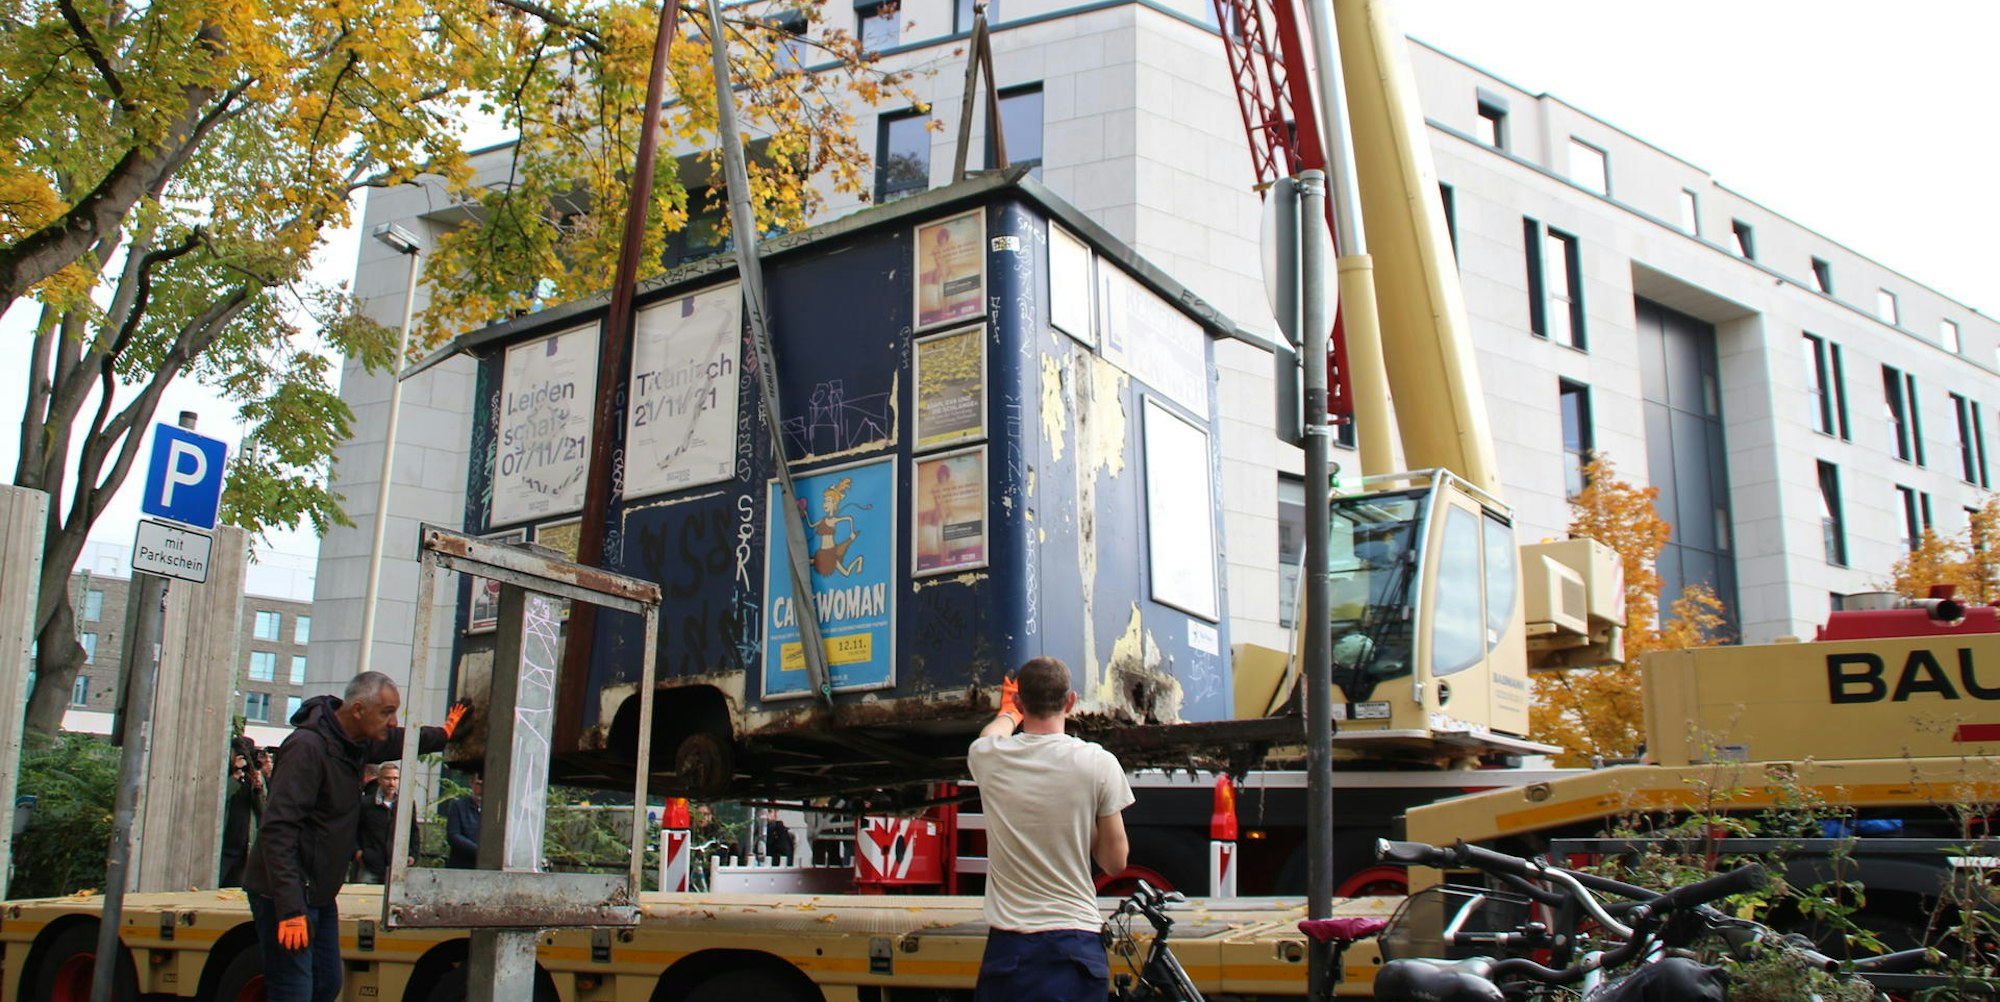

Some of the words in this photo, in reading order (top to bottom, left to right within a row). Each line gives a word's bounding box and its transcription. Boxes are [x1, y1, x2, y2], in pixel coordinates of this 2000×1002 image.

[636, 352, 733, 398] Titanisch
[508, 380, 575, 416] Leiden
[634, 387, 717, 428] 21/11/21
[160, 438, 208, 508] P
[501, 435, 586, 477] 07/11/21
[139, 546, 204, 571] Parkschein
[165, 536, 184, 551] mit
[773, 582, 887, 629] CAWOMAN
[838, 638, 868, 653] 12.11.
[1827, 647, 2000, 705] BAU
